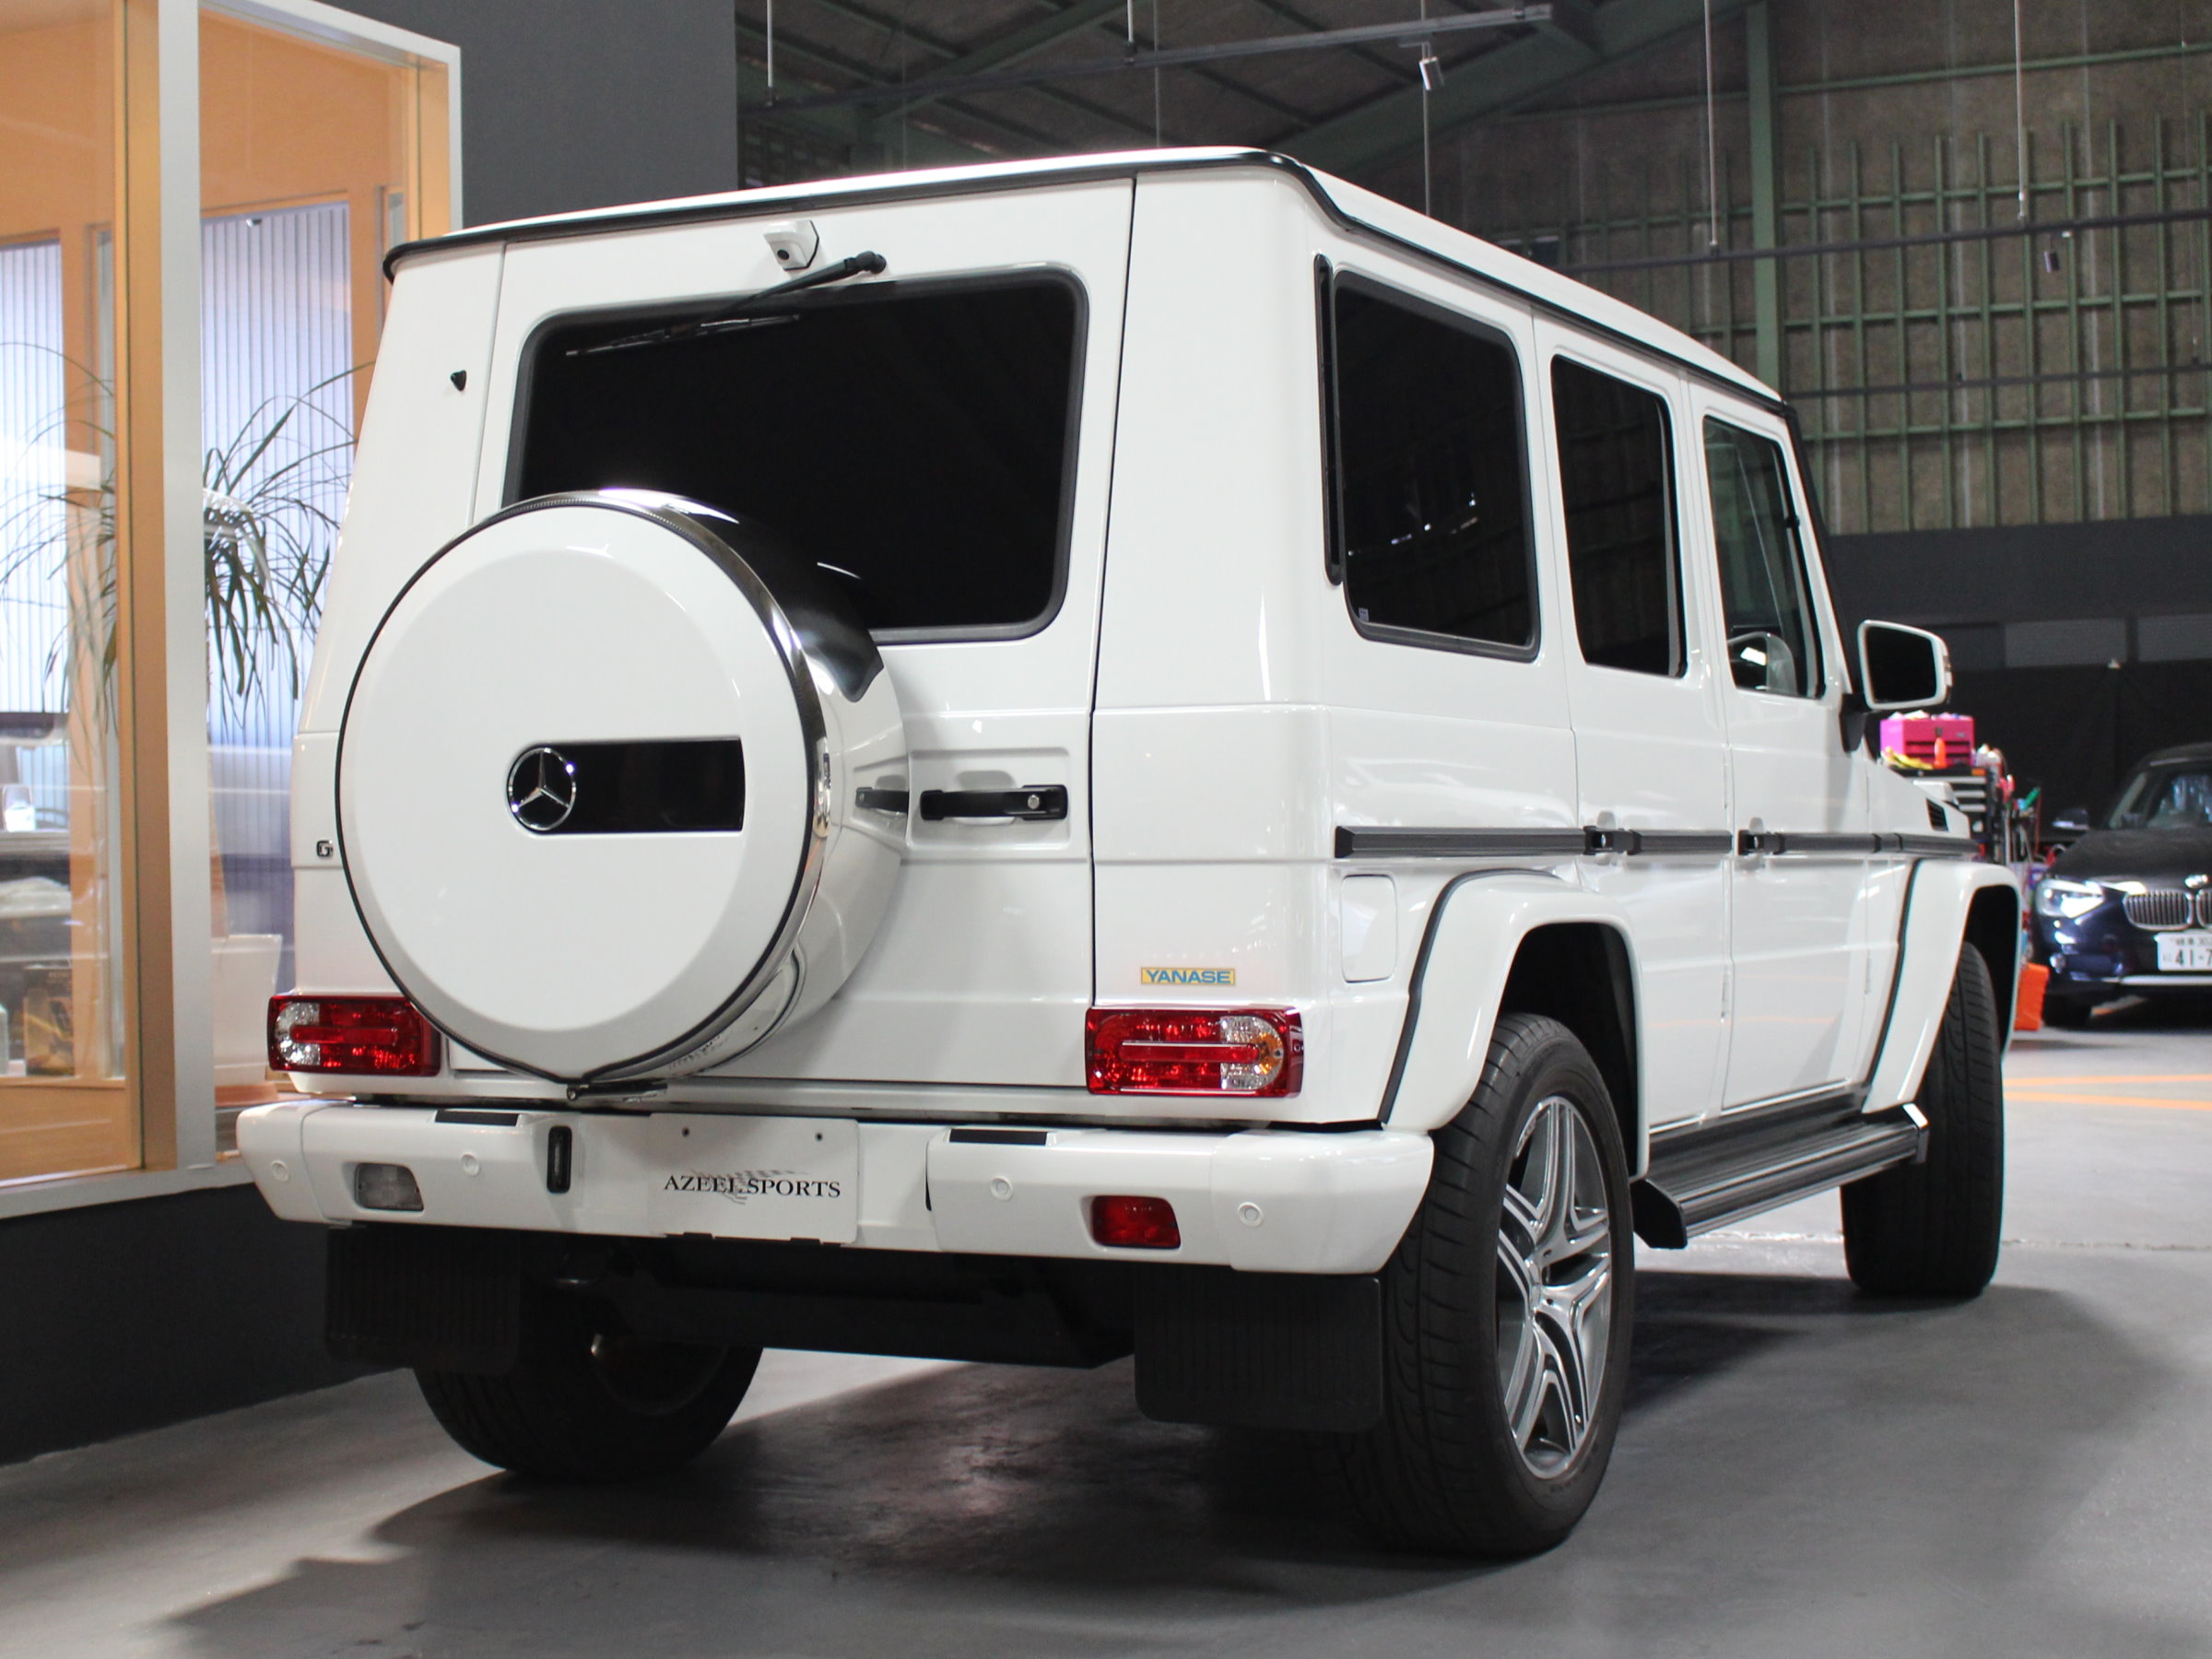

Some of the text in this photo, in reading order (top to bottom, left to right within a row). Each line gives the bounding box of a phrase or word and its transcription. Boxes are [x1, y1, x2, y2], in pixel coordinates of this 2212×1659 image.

[316, 840, 334, 858] G
[1146, 970, 1231, 984] YANASE
[664, 1175, 841, 1198] AZEEL SPORTS
